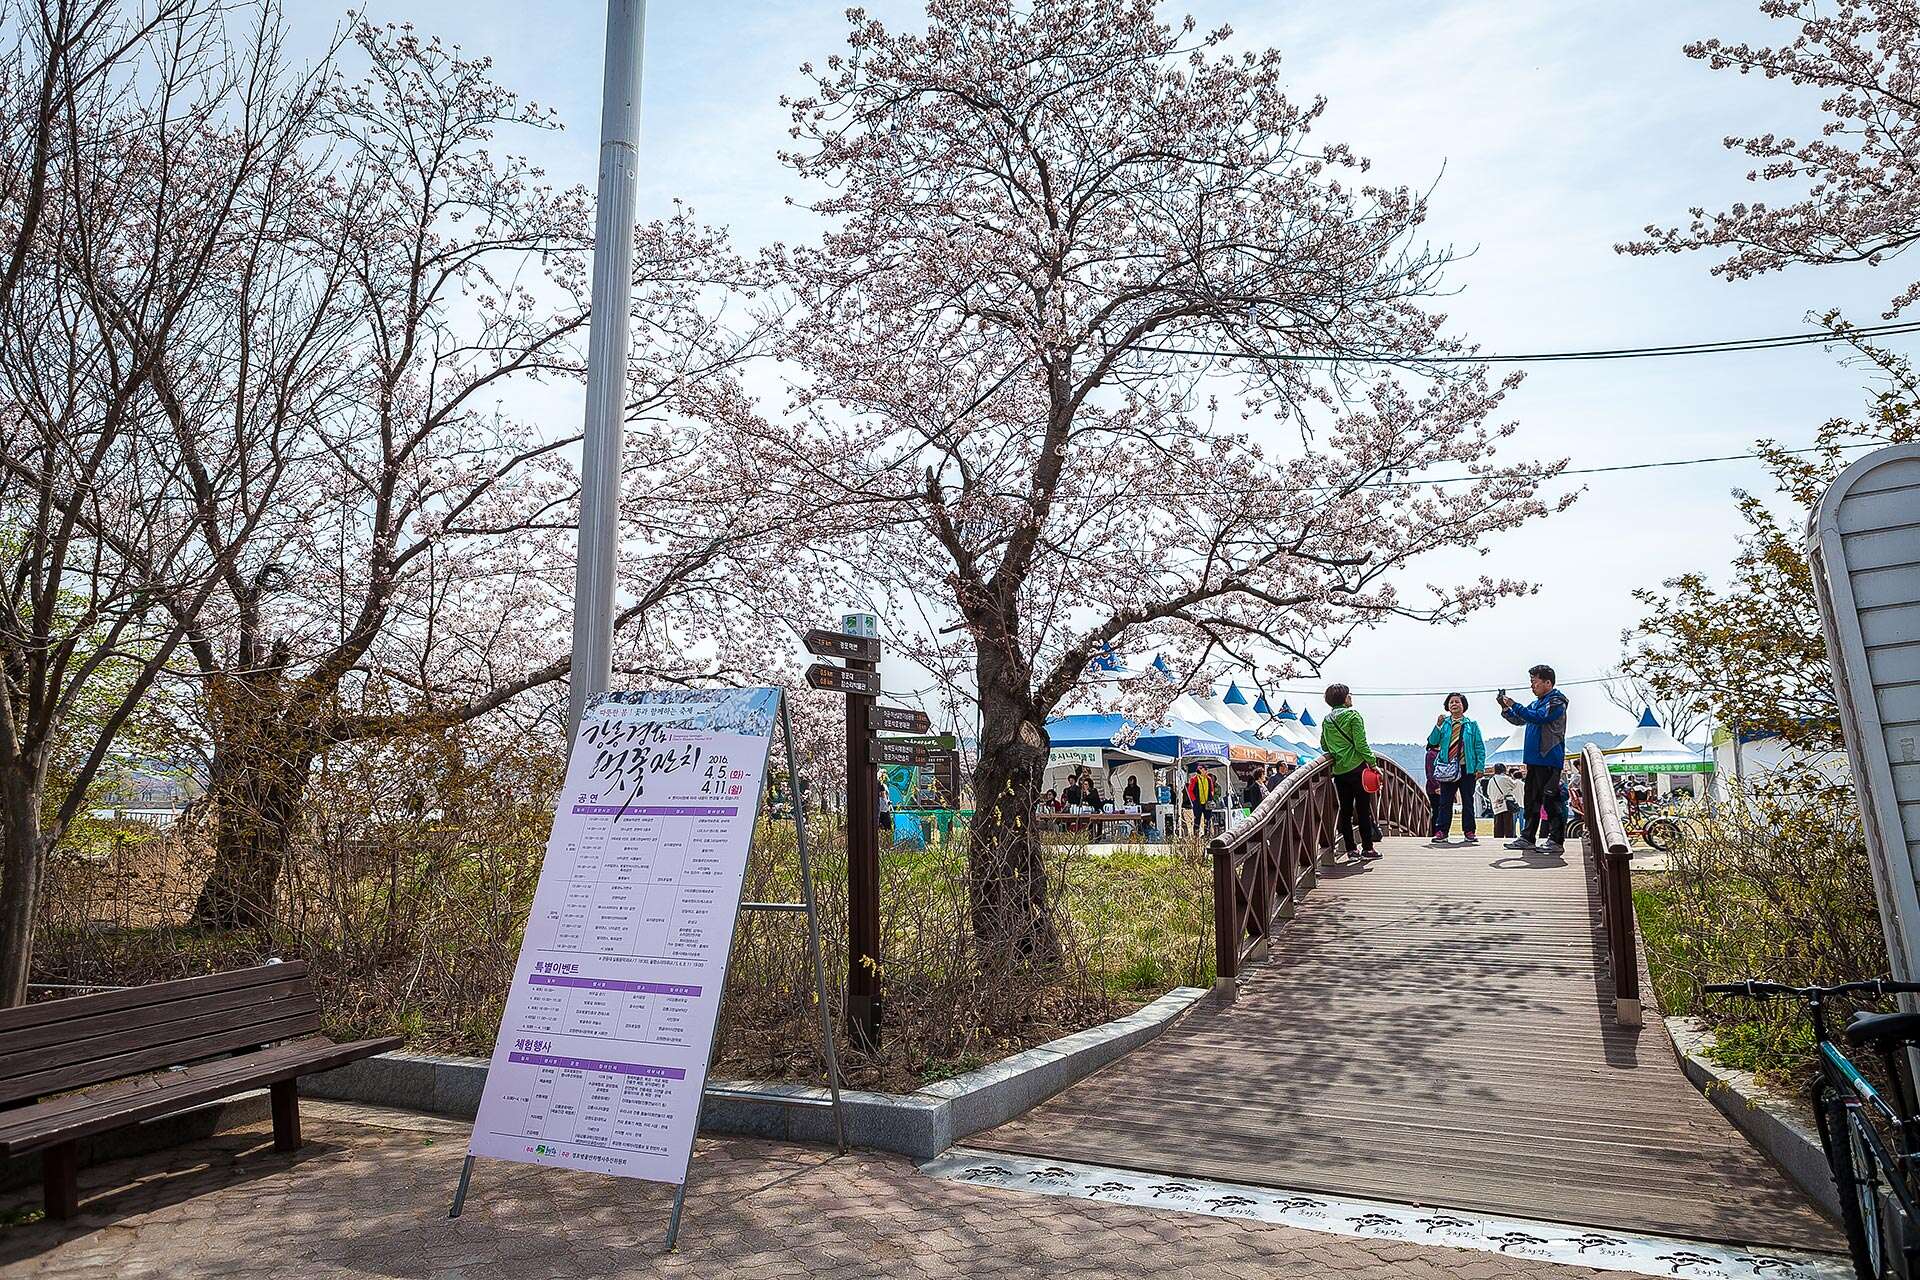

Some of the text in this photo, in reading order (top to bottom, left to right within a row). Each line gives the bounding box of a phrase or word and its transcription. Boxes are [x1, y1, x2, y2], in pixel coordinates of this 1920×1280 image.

[841, 671, 854, 680] 경포대
[600, 708, 619, 717] 따뜻한
[651, 706, 676, 716] 함께하는
[535, 961, 579, 975] 특별이벤트
[514, 1039, 552, 1053] 체험행사
